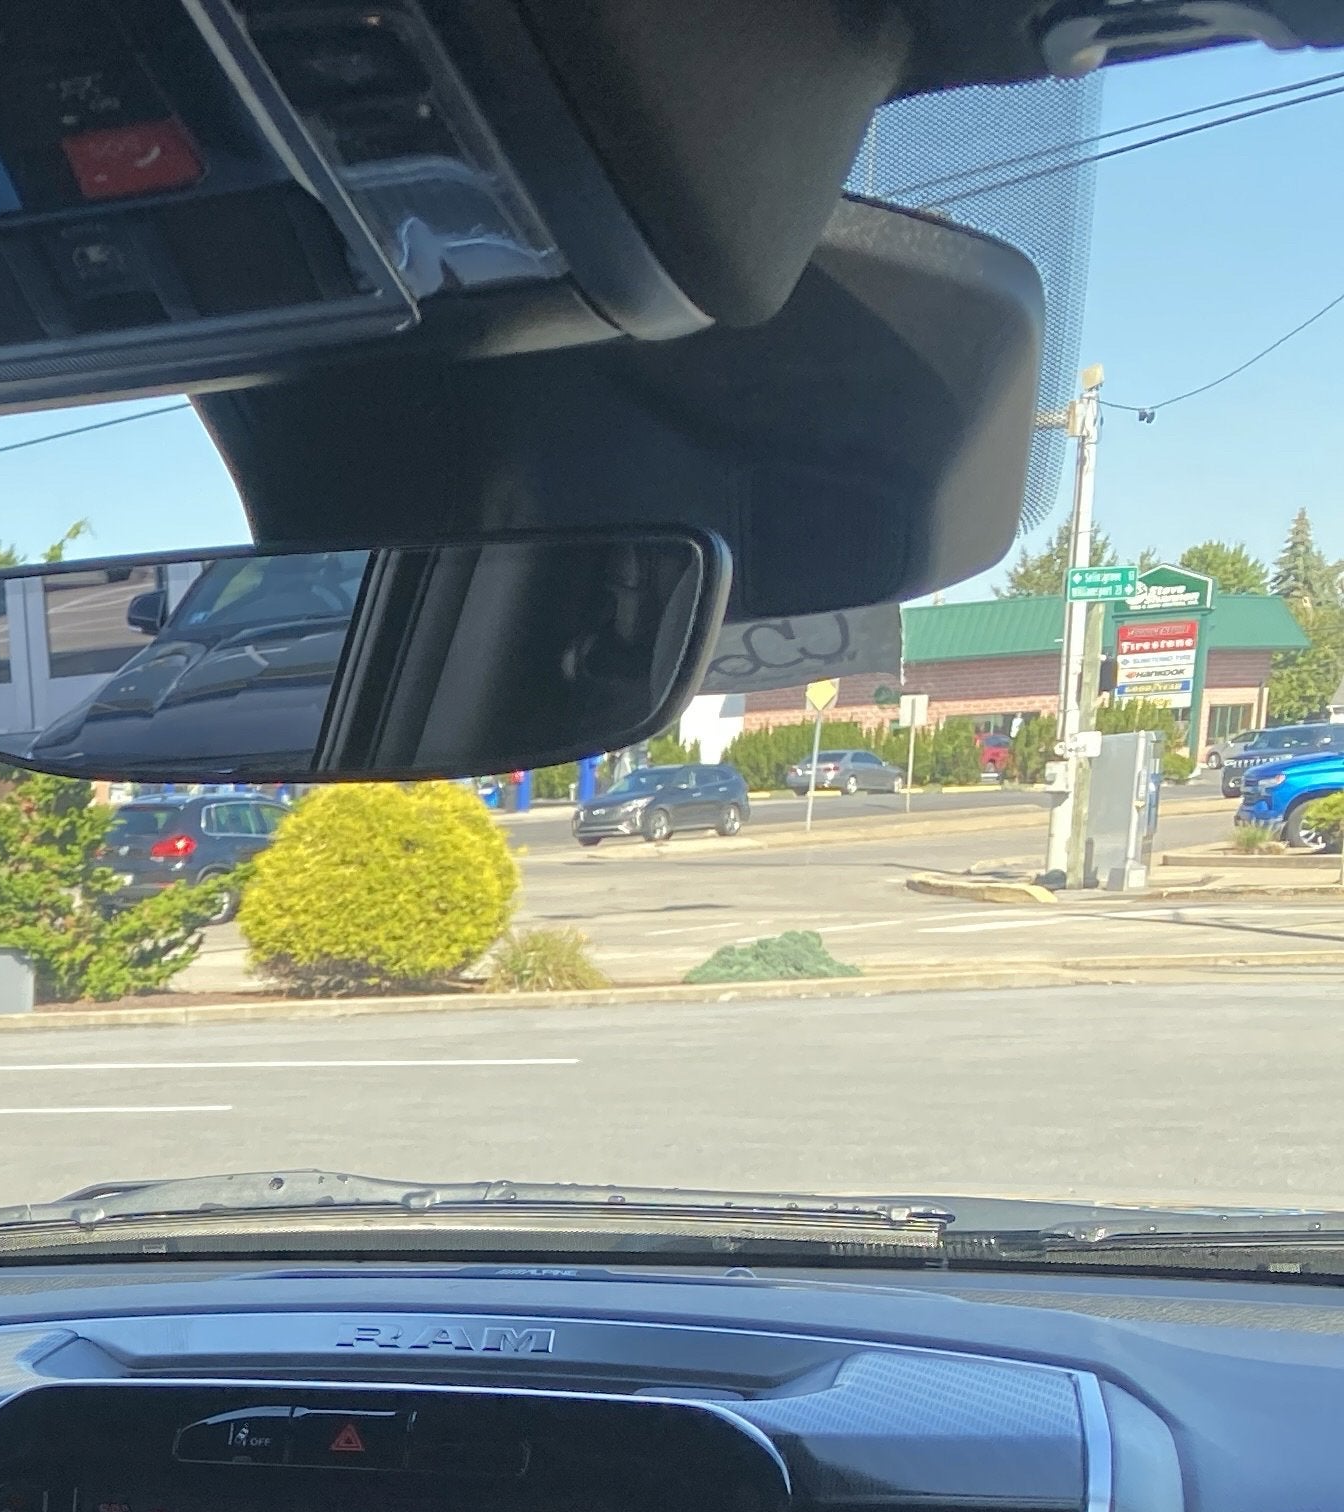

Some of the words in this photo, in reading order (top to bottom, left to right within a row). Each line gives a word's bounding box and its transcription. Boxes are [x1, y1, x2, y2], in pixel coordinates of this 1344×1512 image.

[1121, 638, 1193, 653] Firestone
[335, 1321, 556, 1354] RAM
[250, 1436, 272, 1449] OFF
